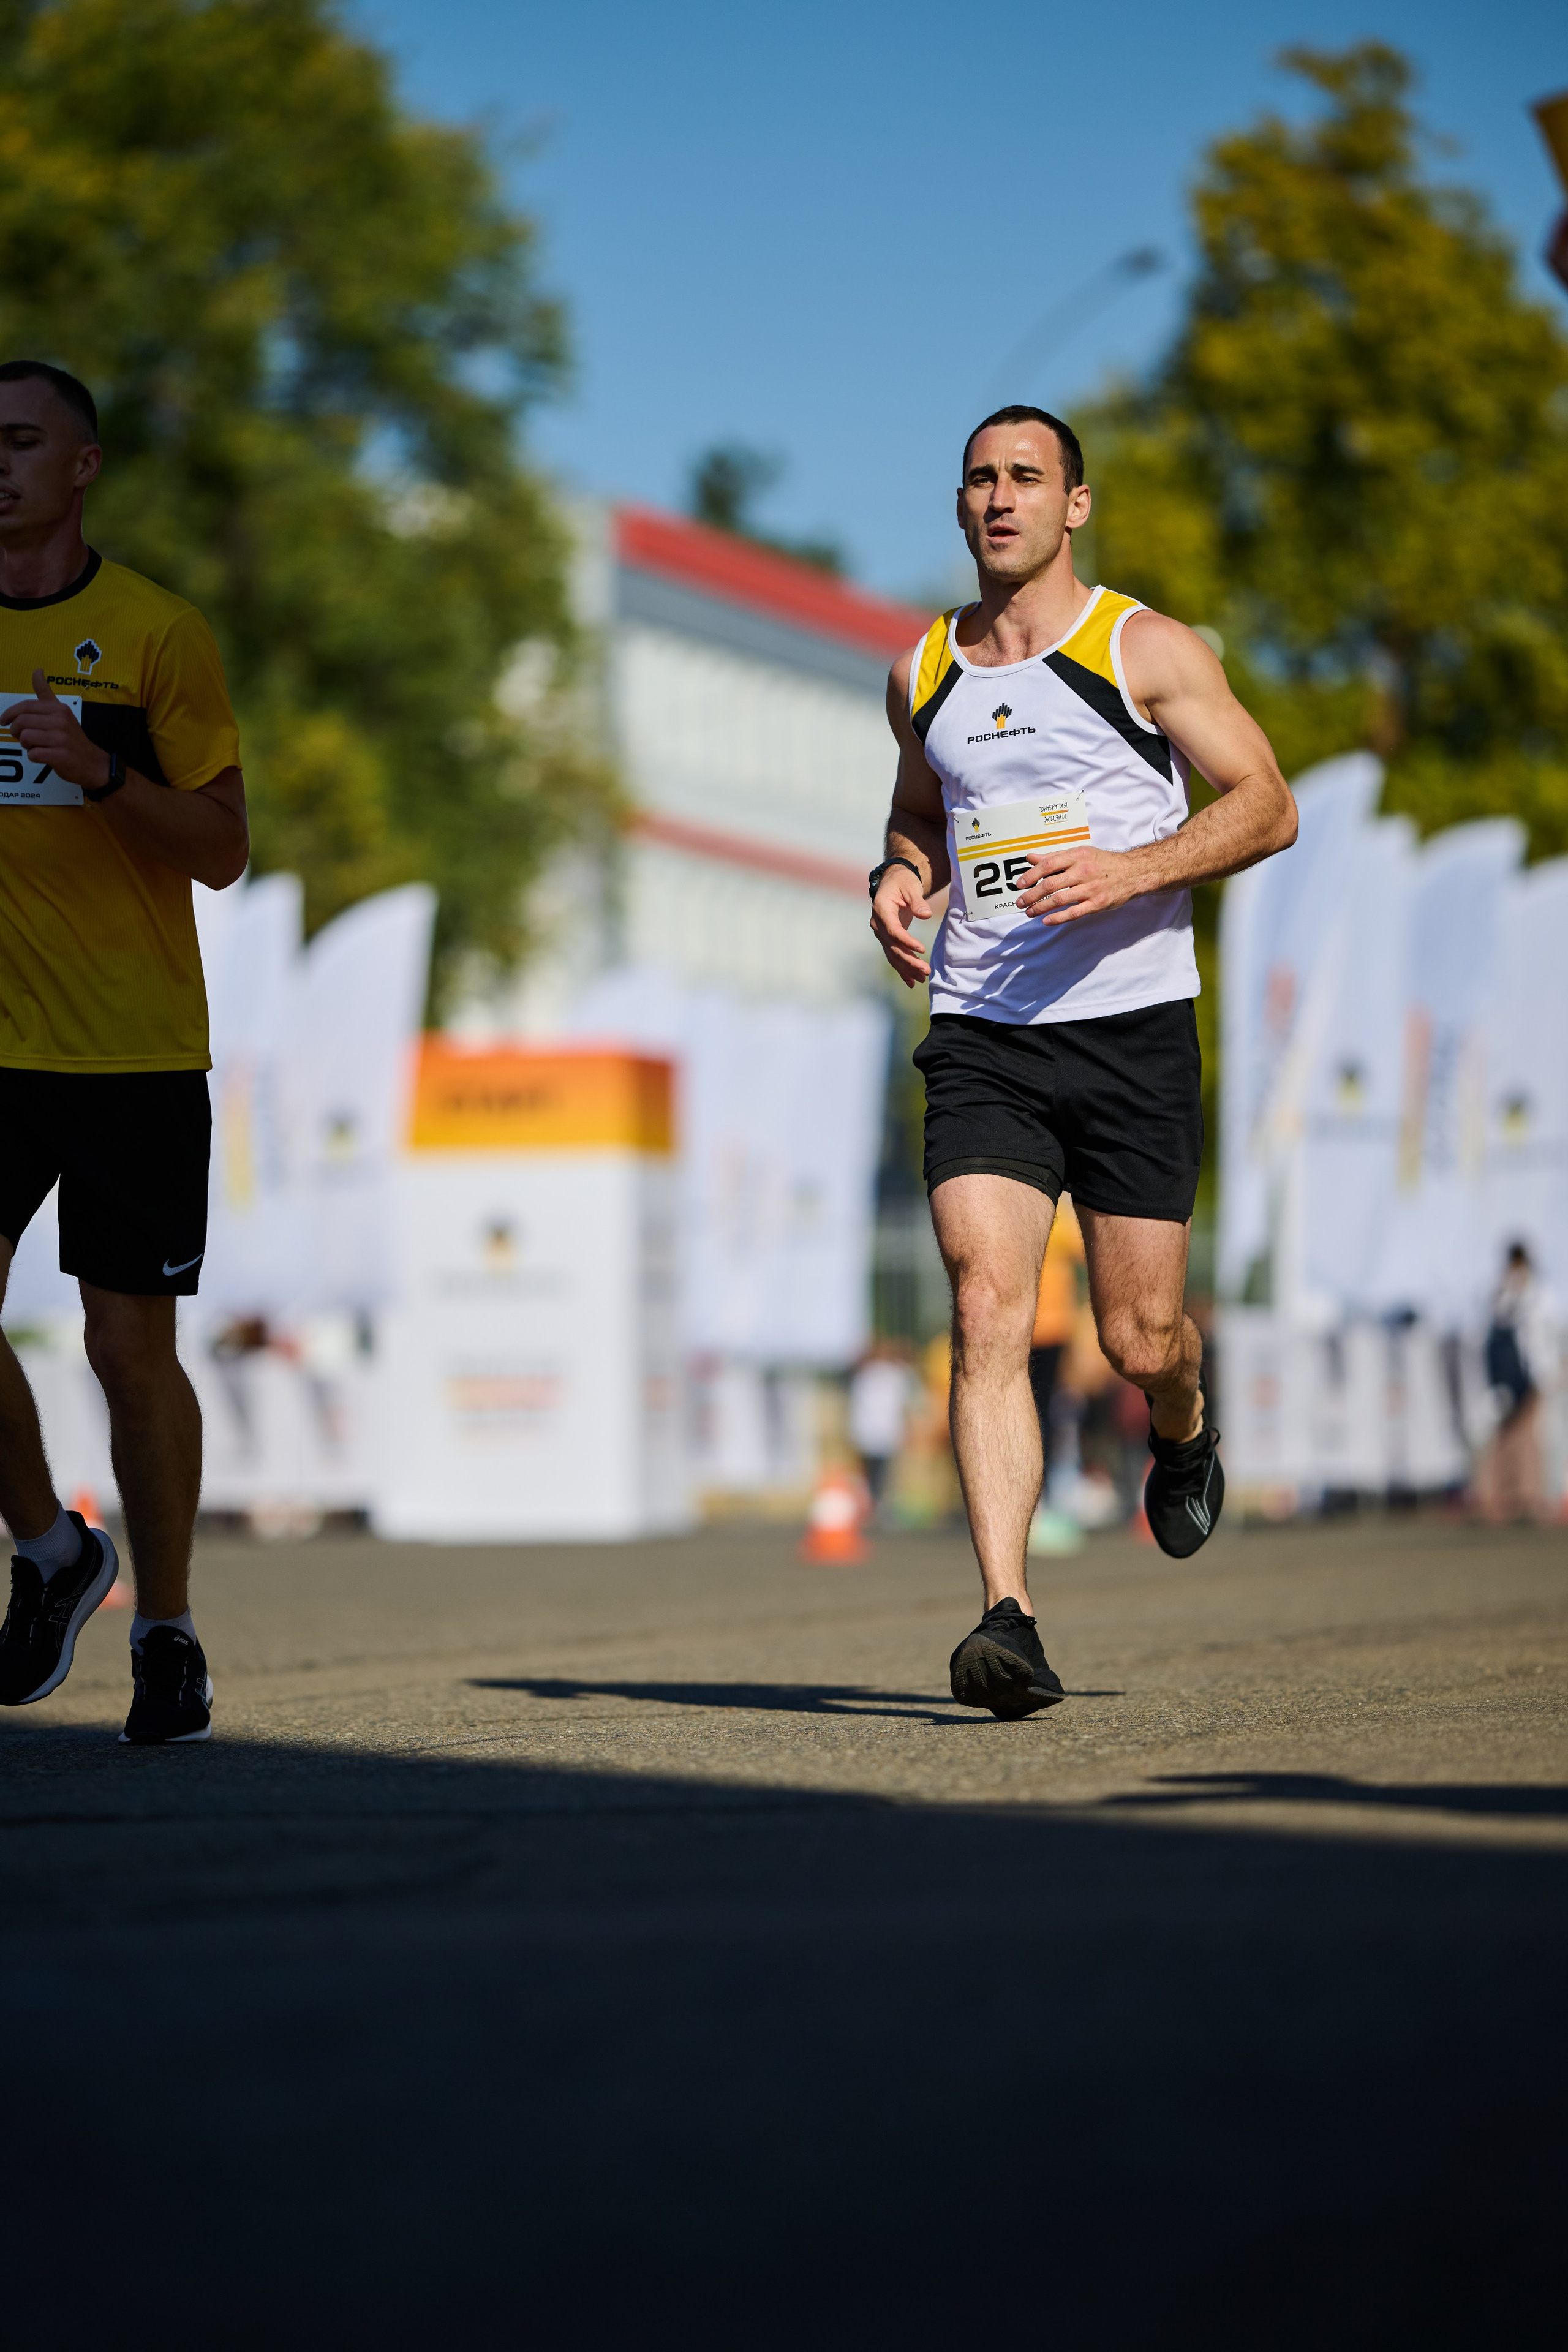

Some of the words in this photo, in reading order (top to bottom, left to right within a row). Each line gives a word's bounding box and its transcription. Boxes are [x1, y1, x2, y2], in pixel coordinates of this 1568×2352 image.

[47, 676, 119, 689] РОСНЕФТЬ
[967, 727, 1036, 744] РОСНЕФТЬ
[1044, 814, 1067, 823] ЖИЗНИ
